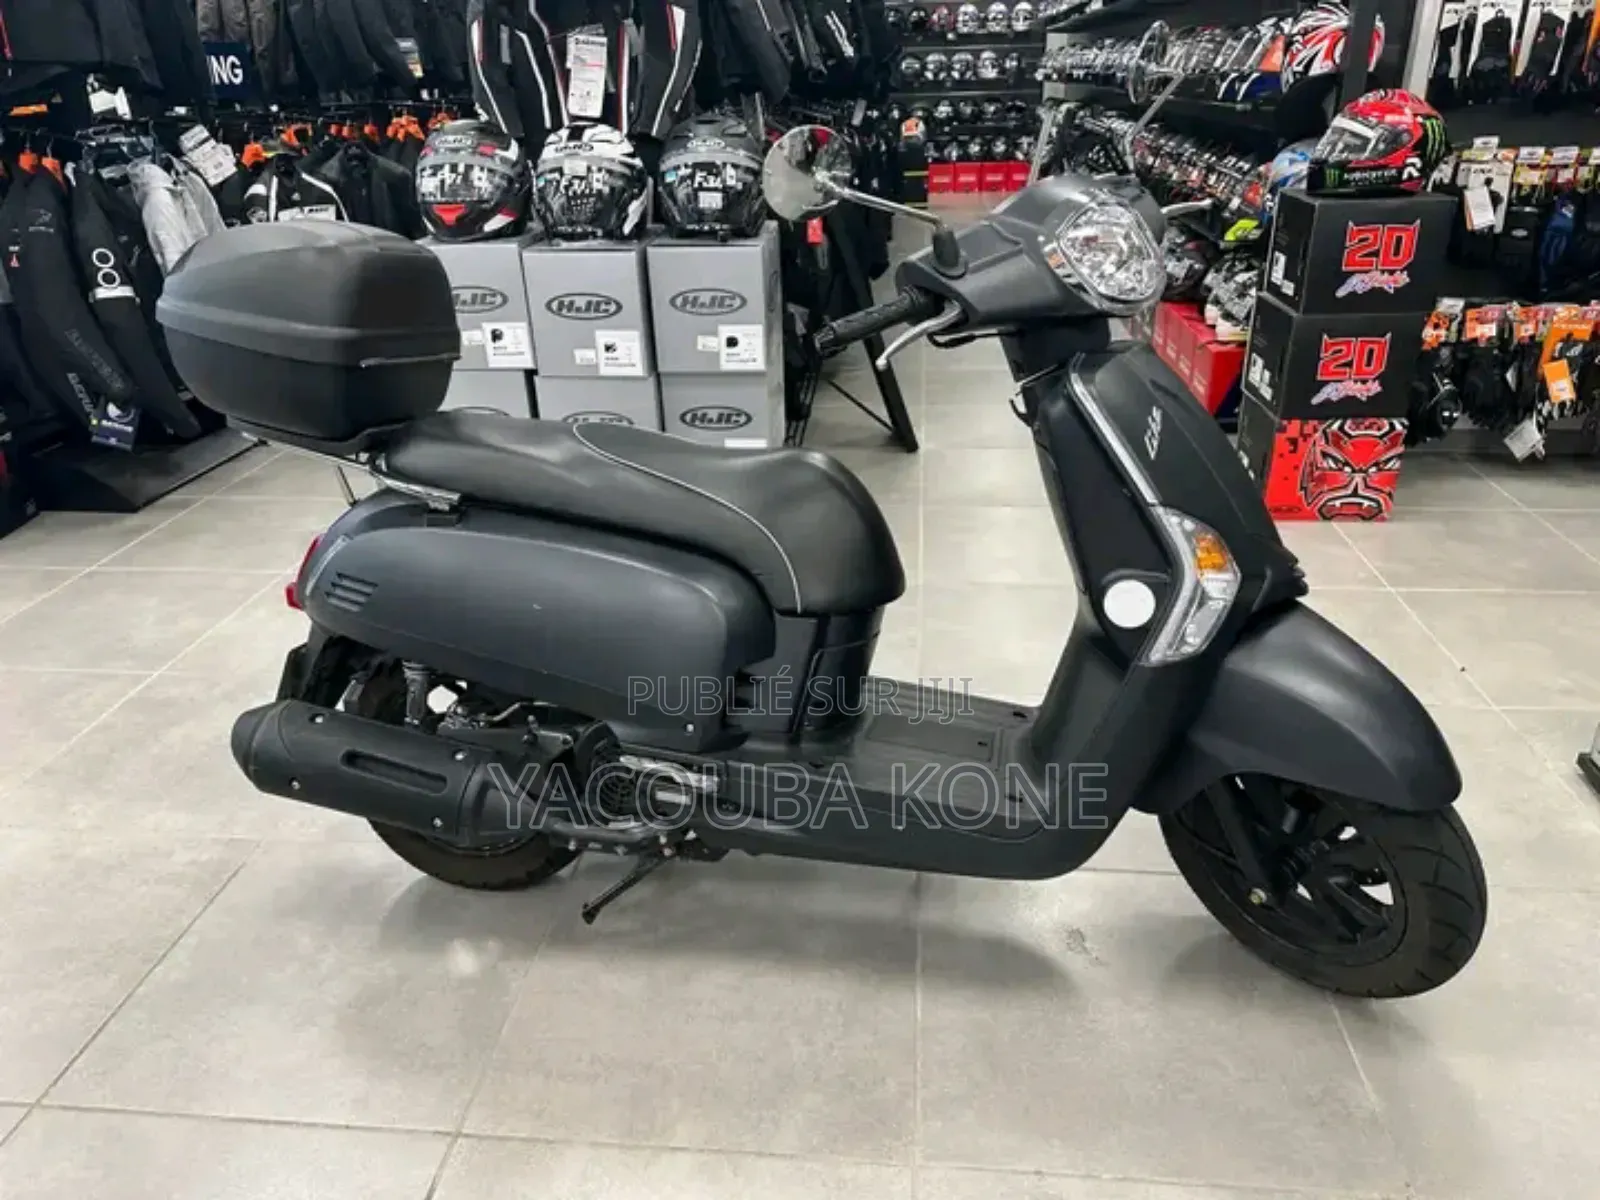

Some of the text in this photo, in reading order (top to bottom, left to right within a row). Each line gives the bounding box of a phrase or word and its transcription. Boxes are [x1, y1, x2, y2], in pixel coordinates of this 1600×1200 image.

[557, 300, 612, 314] HJC
[679, 295, 737, 309] HJC
[689, 413, 743, 425] HJC
